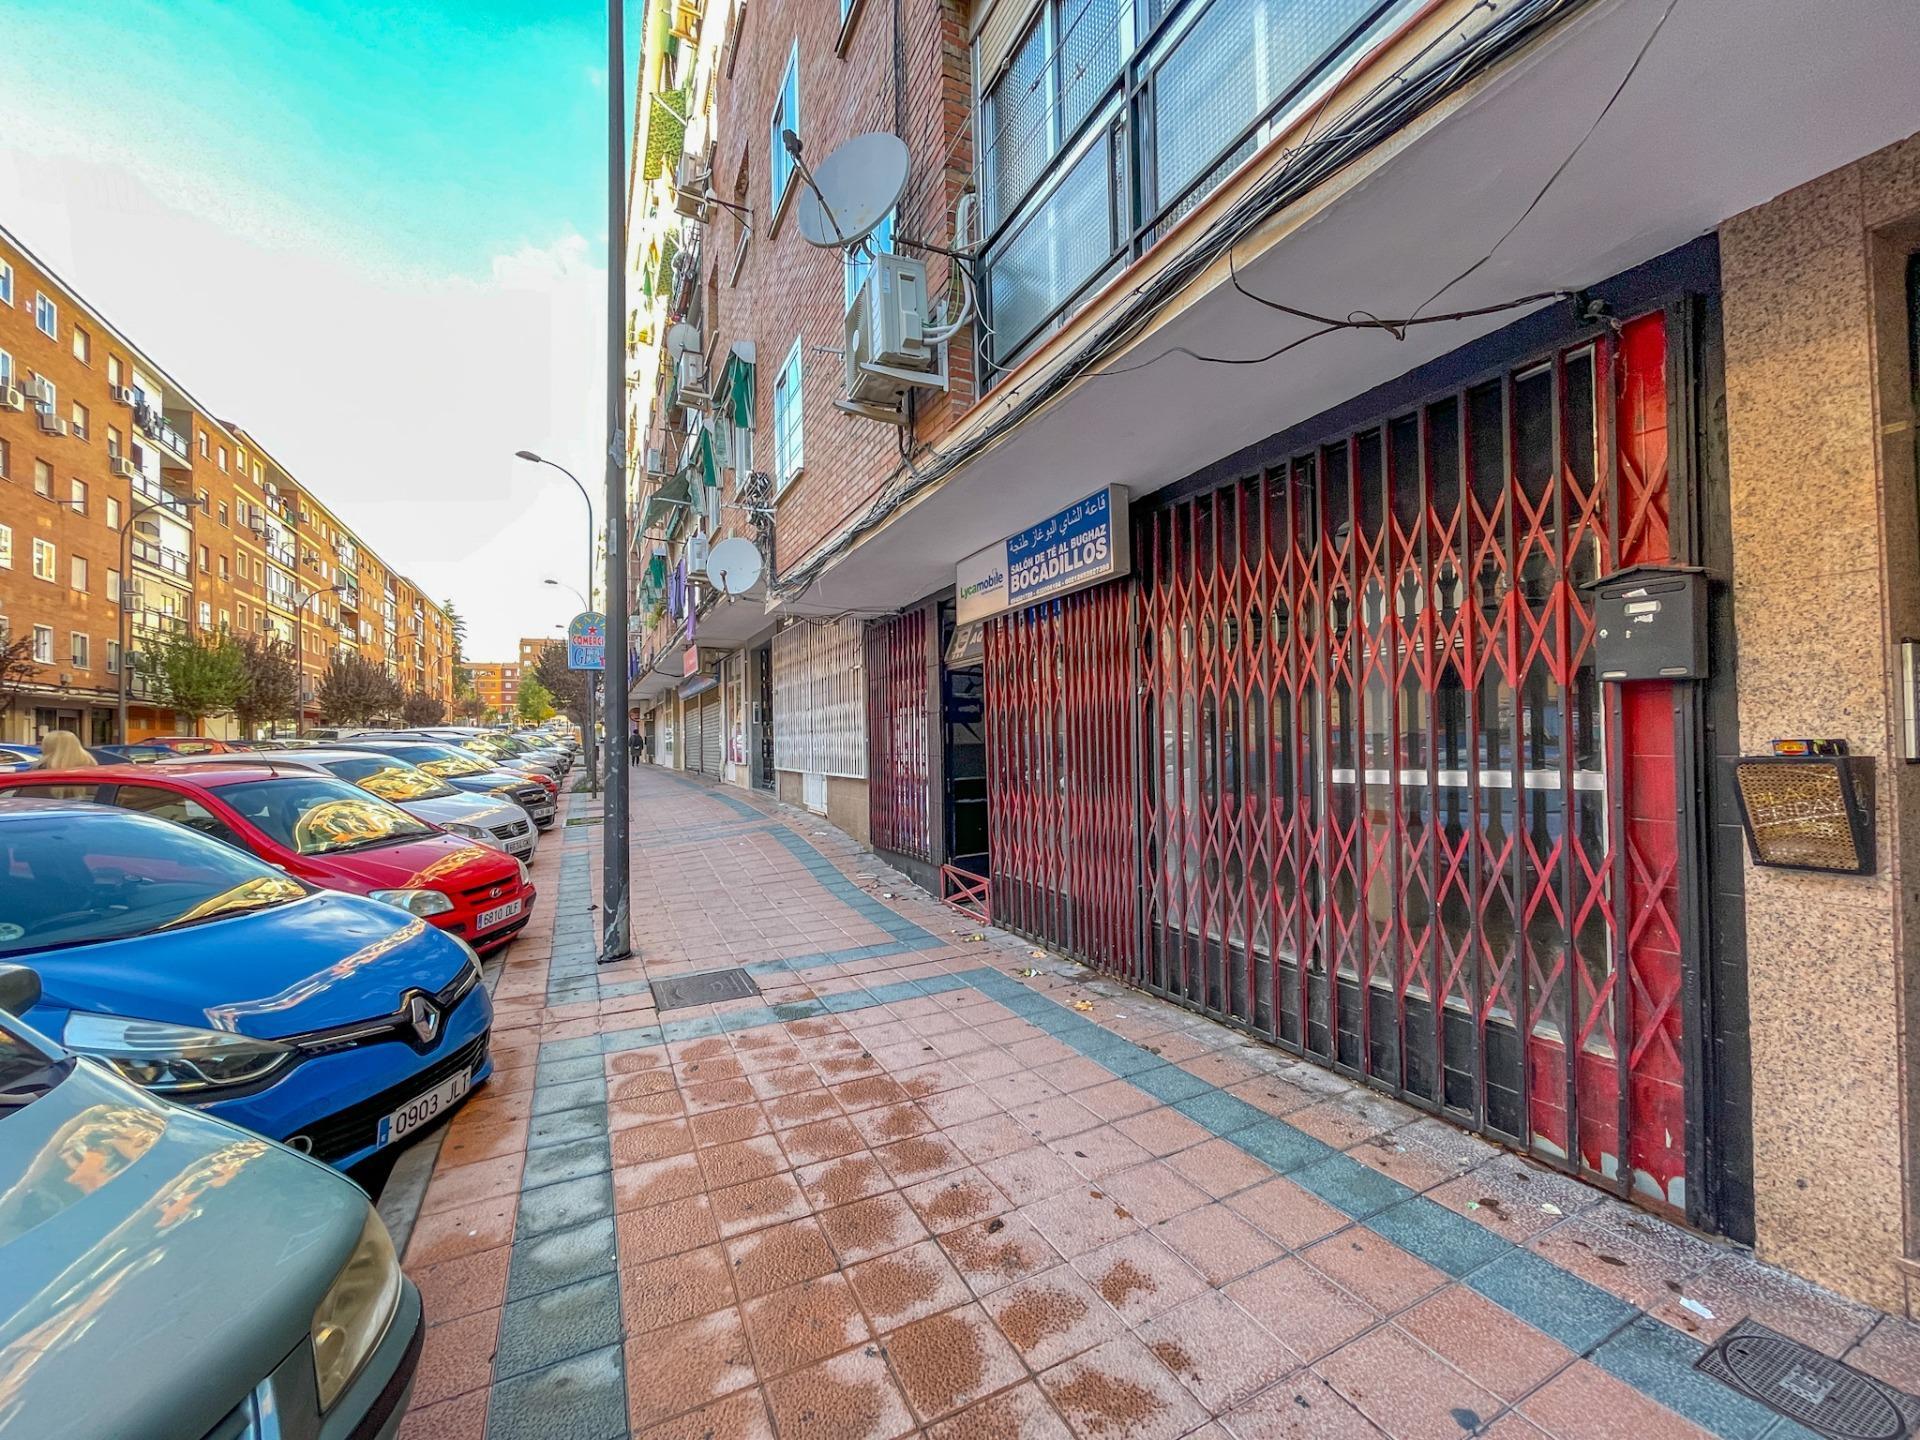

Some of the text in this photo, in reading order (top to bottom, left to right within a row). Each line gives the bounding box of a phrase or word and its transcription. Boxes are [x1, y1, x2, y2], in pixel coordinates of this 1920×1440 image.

[1010, 523, 1107, 575] SALÓN DE TÉ AL BUGHAZ
[1010, 537, 1108, 593] BOCADILLOS
[960, 571, 1004, 599] Lycamobile
[1757, 796, 1843, 821] FRIDAY
[484, 908, 502, 925] 6810
[396, 1071, 469, 1134] 0903 JLT
